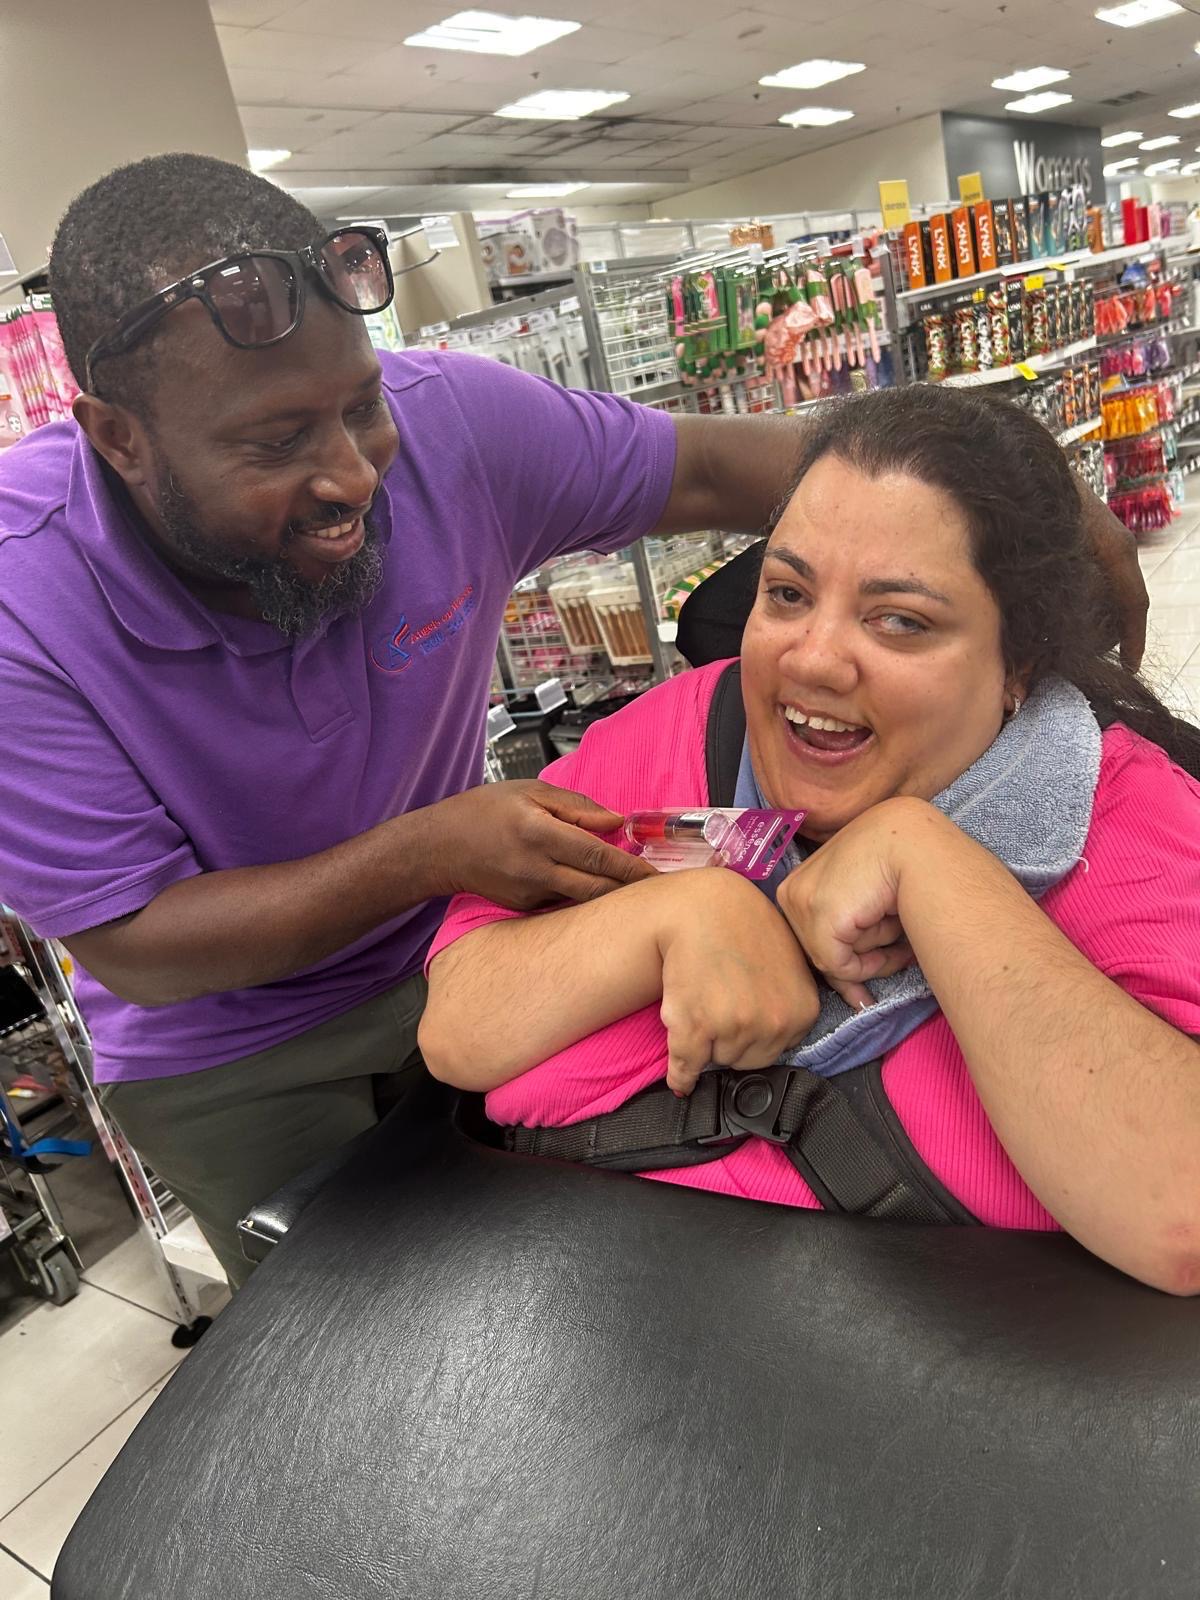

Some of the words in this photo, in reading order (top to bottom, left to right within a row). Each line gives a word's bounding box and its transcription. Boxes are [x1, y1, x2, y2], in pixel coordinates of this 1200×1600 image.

[908, 235, 921, 277] LYNX
[934, 228, 947, 270] LYNX
[957, 221, 970, 264] LYNX
[979, 214, 992, 258] LYNX
[736, 821, 765, 862] essence
